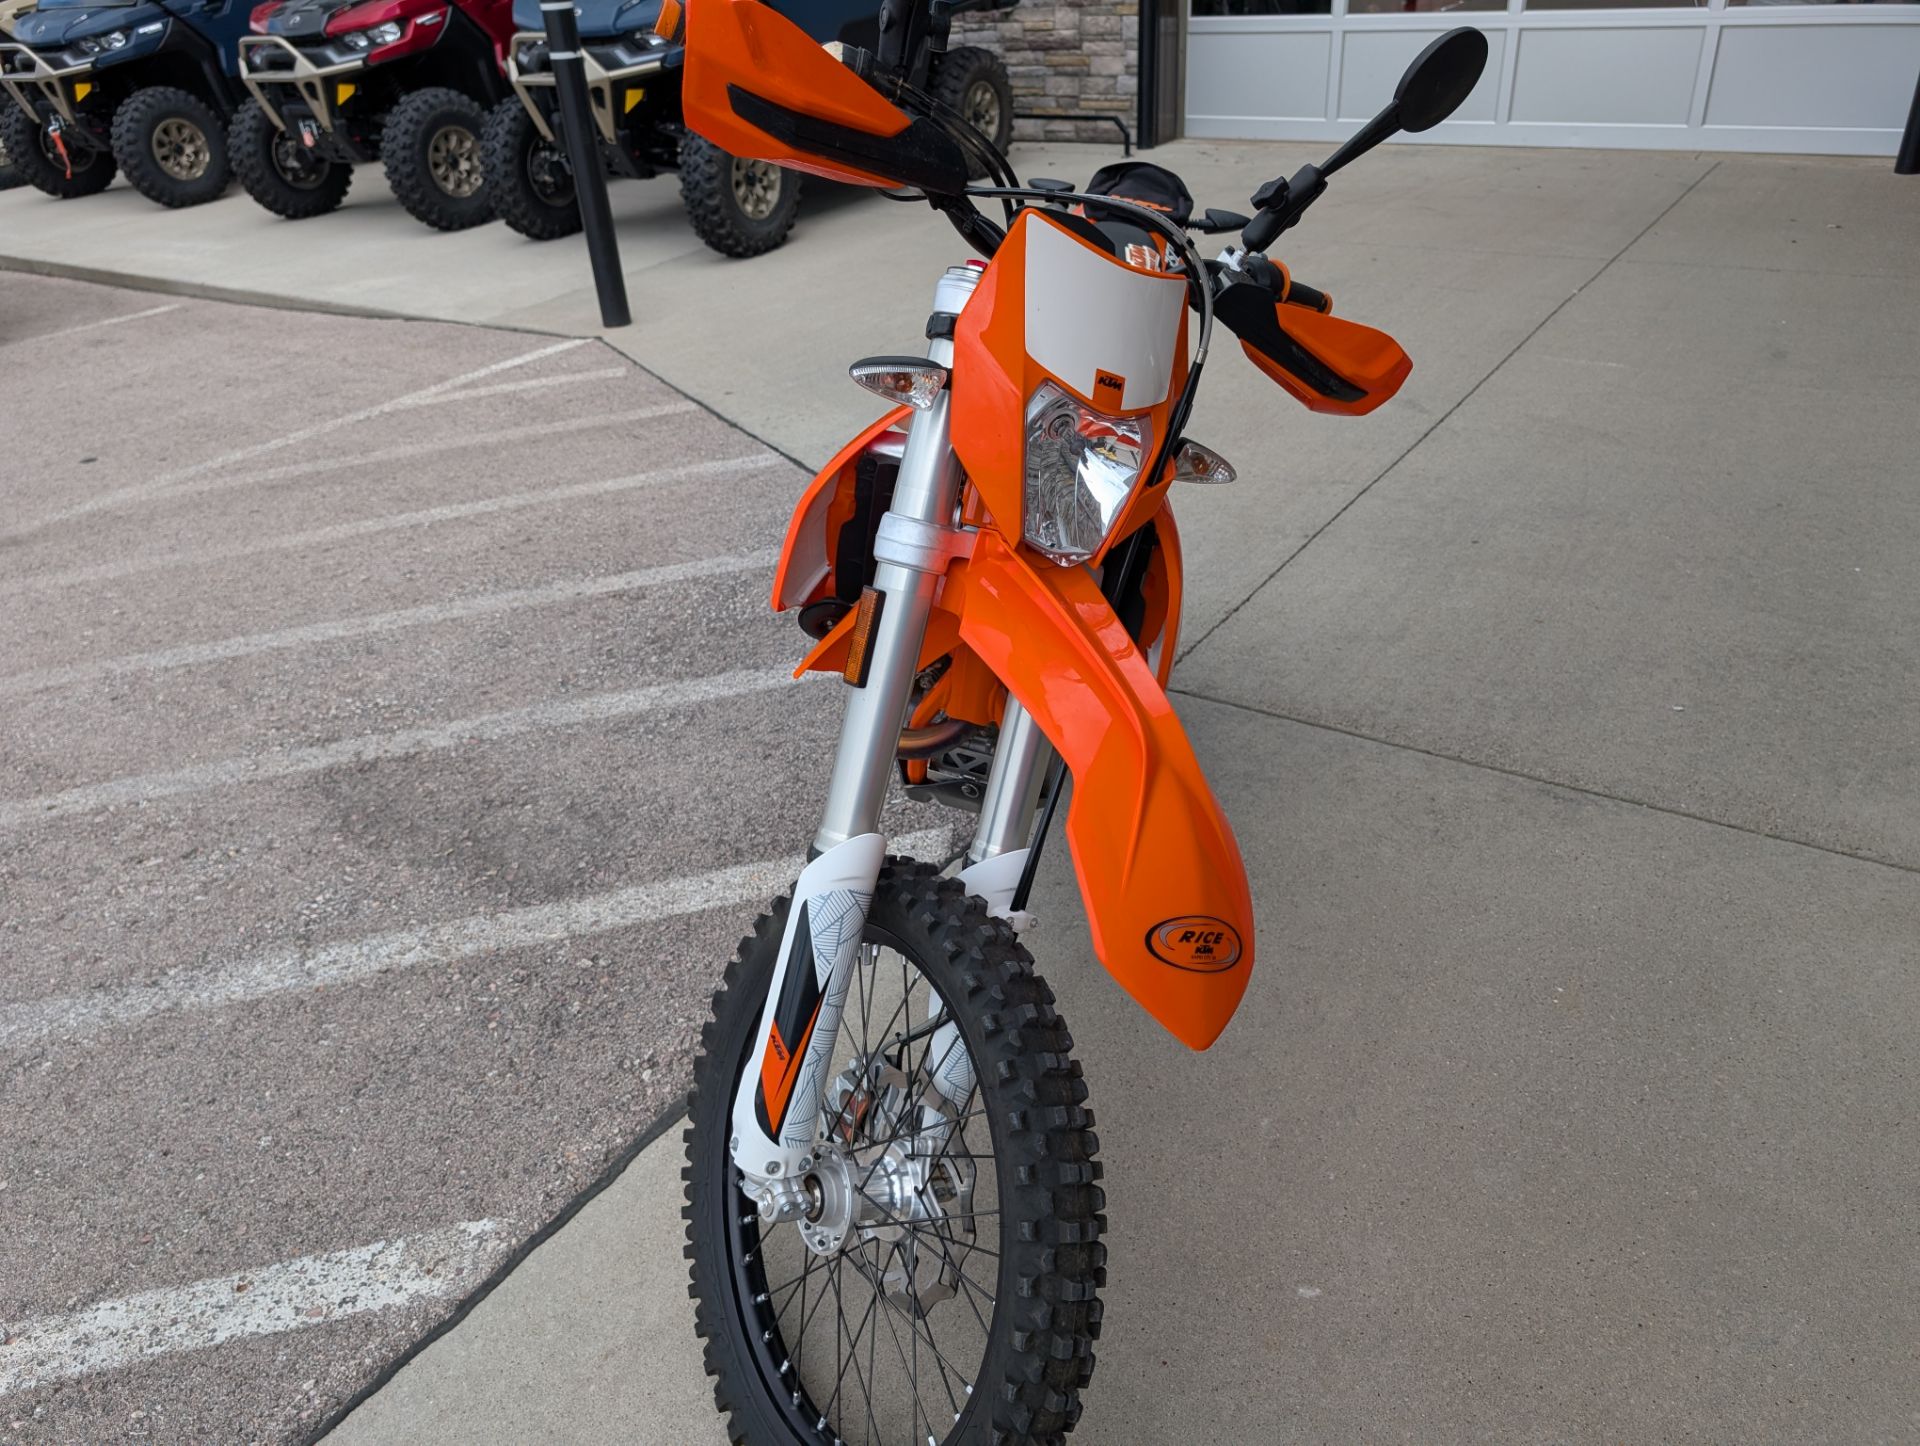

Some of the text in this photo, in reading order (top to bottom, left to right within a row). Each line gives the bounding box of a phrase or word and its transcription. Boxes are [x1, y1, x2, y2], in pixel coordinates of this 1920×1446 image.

[1098, 375, 1122, 391] KTM
[1178, 931, 1224, 944] RICE
[771, 1034, 786, 1060] KTM
